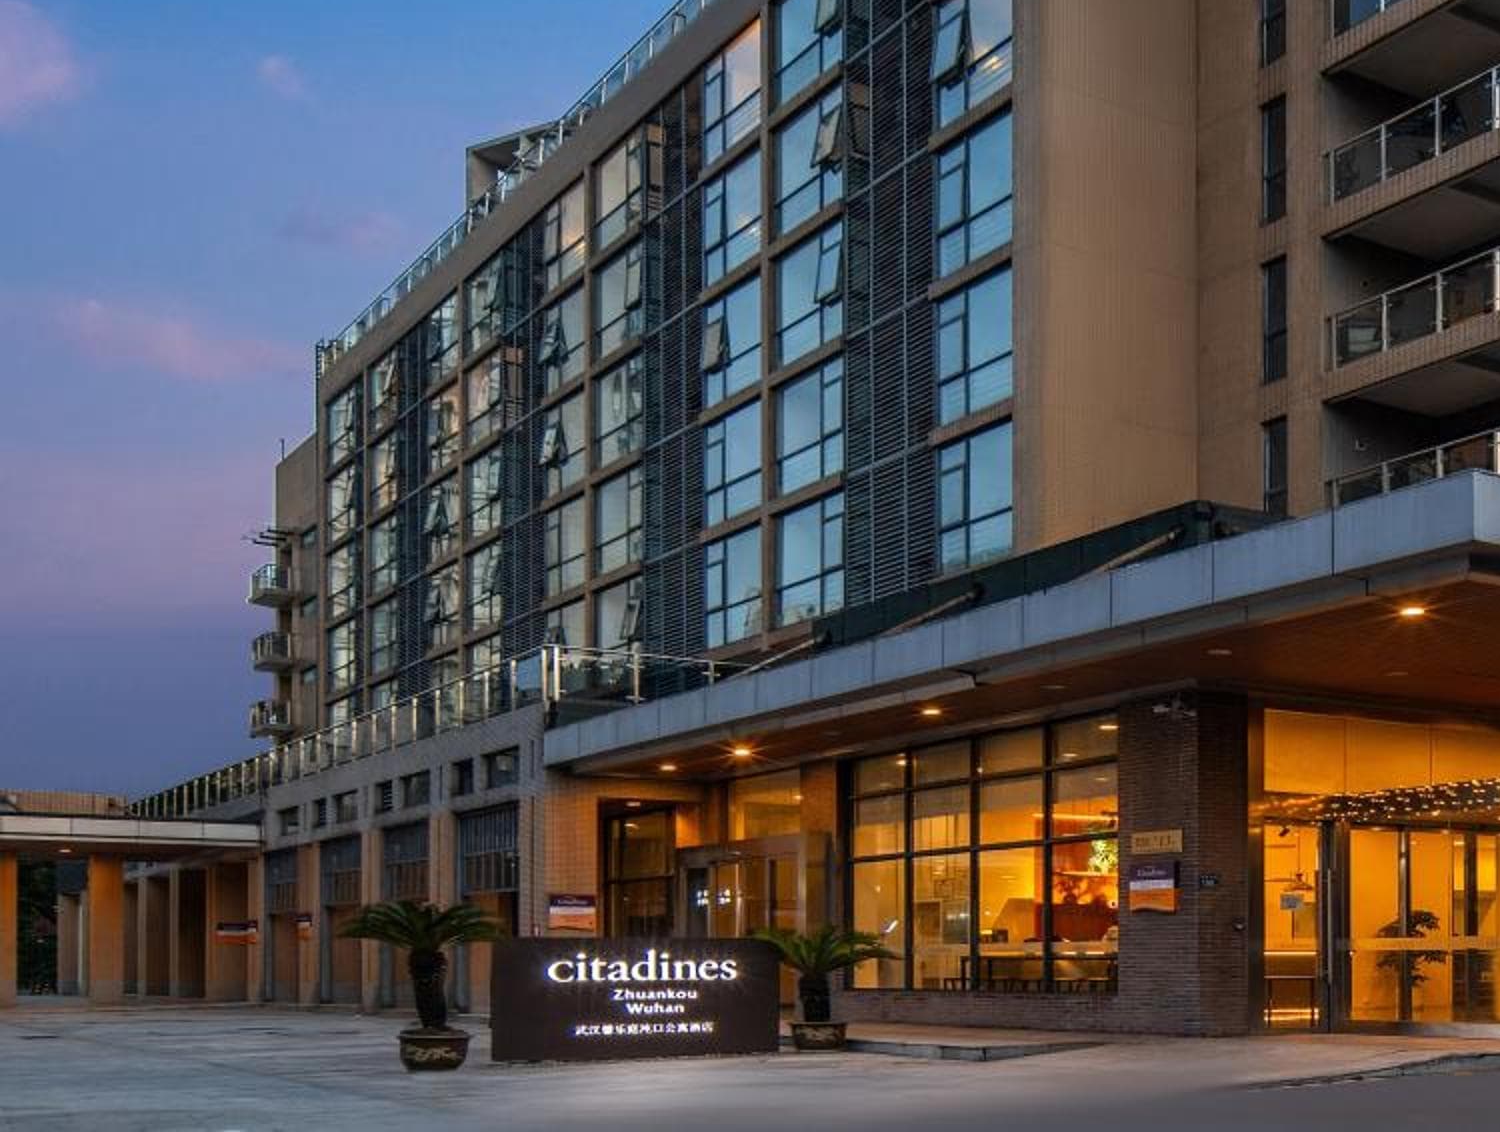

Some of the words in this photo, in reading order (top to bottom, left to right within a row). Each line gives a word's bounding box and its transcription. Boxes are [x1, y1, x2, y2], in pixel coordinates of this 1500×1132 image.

[547, 948, 738, 983] citadines
[612, 988, 698, 1001] Zhuankou
[625, 1002, 686, 1015] Wuhan
